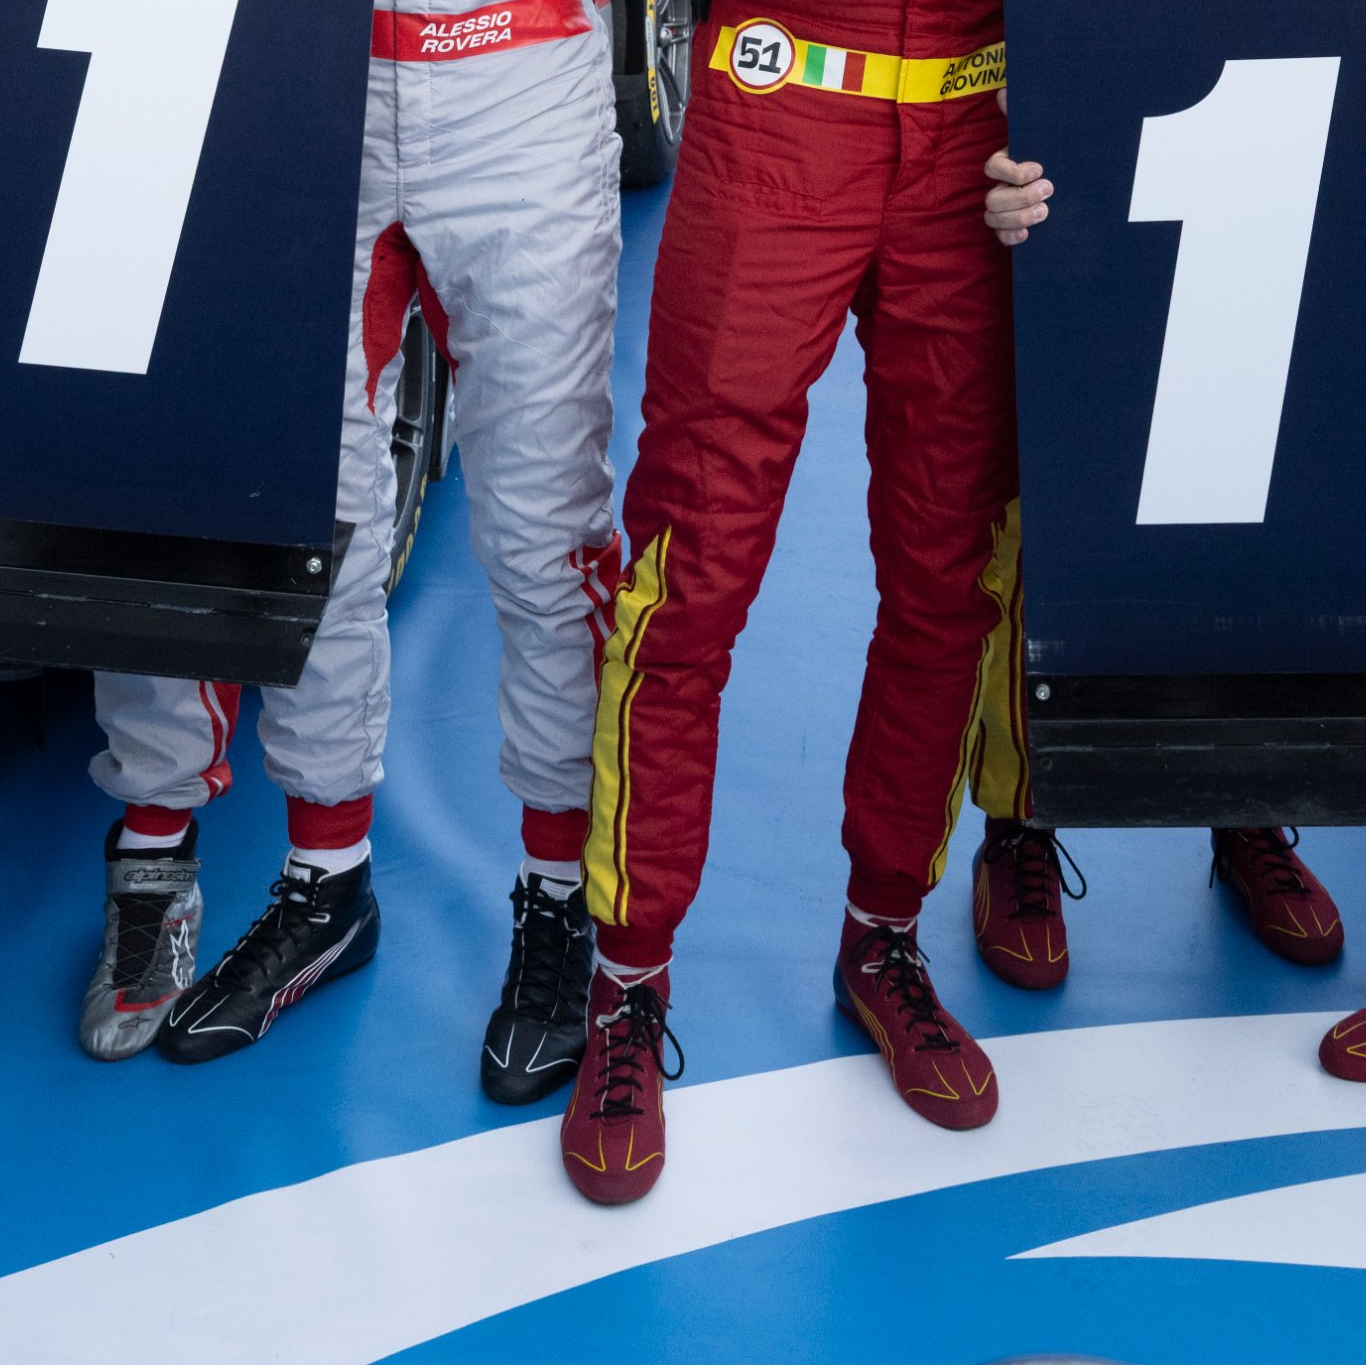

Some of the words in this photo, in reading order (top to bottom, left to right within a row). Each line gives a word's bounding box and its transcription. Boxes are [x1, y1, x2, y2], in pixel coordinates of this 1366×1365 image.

[420, 11, 512, 37] ALESSIO
[420, 28, 512, 53] ROVERA
[738, 36, 782, 74] 51
[943, 47, 1004, 78] ANTONI
[1128, 56, 1341, 525] 1
